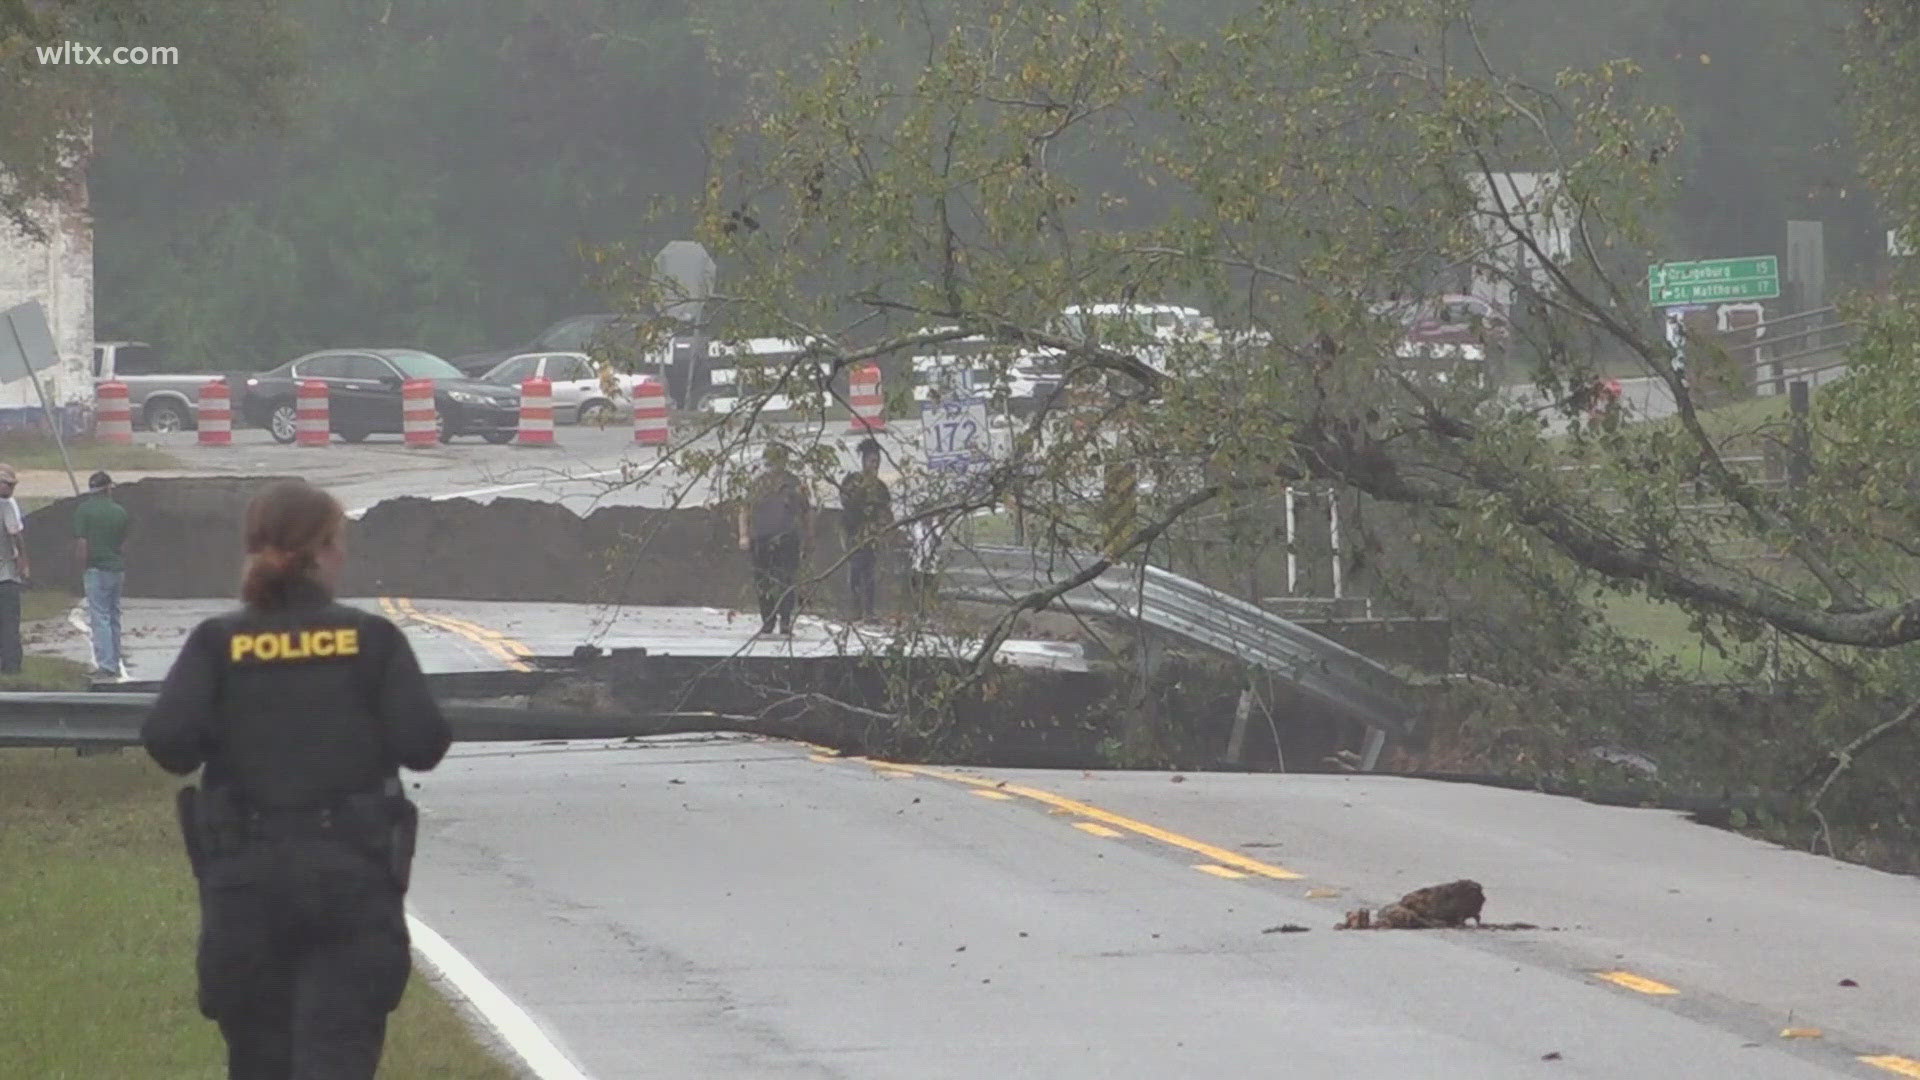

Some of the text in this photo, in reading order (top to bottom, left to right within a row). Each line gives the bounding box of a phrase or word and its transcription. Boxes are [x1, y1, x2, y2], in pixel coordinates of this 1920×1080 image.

[1758, 280, 1770, 293] 17
[933, 419, 978, 452] 172
[231, 628, 359, 662] POLICE
